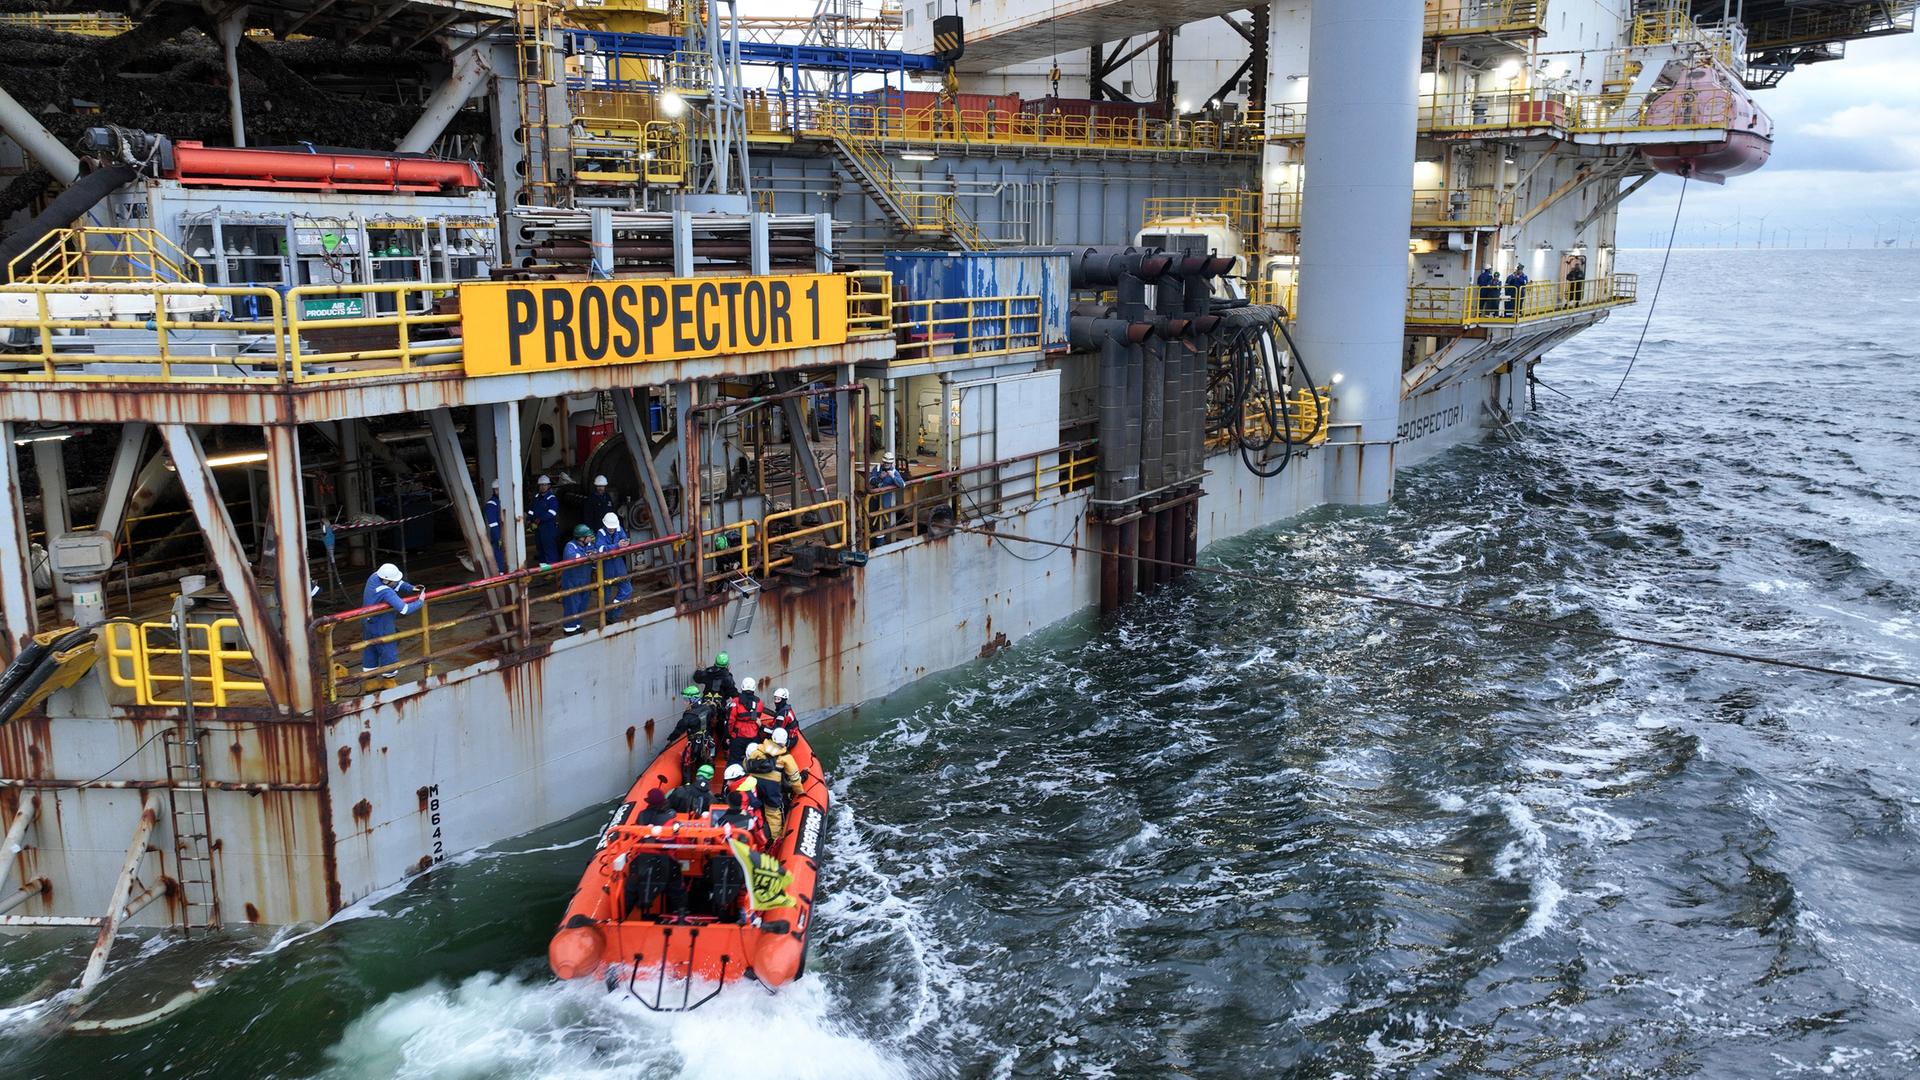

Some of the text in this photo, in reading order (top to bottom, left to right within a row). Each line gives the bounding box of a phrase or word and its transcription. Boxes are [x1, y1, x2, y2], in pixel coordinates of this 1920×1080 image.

[306, 308, 346, 317] PRODUCTS
[331, 302, 345, 310] AIR
[506, 279, 820, 366] PROSPECTOR 1
[1397, 406, 1459, 444] PROSPECTOR
[800, 807, 822, 858] GREENPEACE
